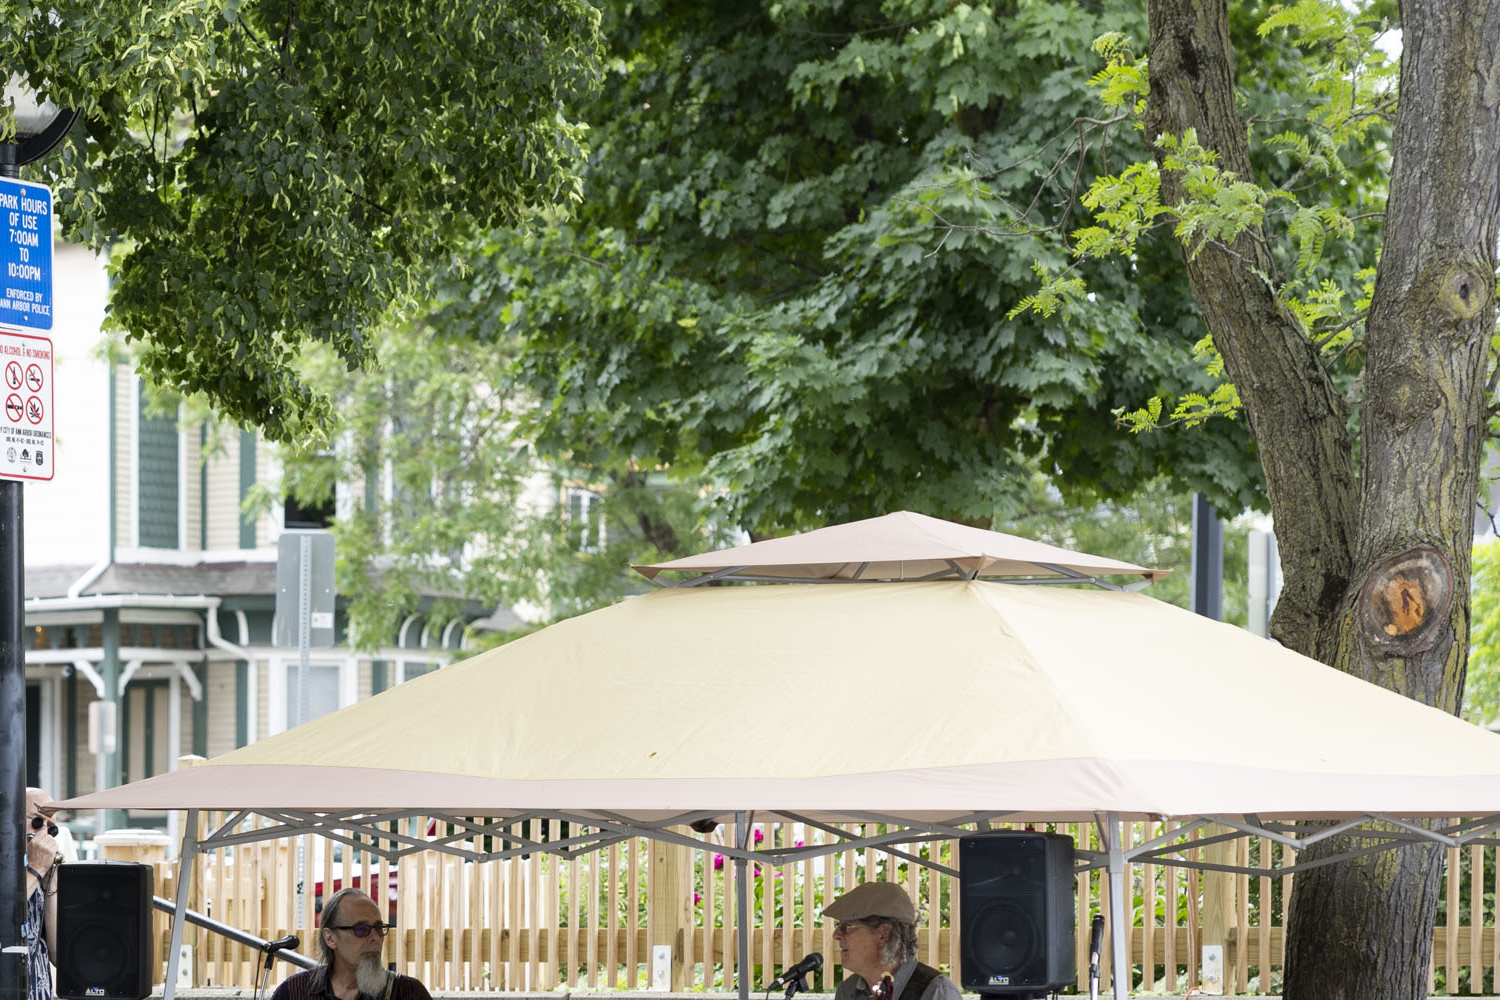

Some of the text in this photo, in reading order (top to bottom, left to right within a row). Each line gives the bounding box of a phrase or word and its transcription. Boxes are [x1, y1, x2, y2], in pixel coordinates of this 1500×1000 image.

[21, 197, 48, 215] HOURS
[9, 211, 38, 230] OF USE
[9, 228, 39, 247] 7:00AM
[19, 247, 29, 262] TO
[8, 262, 41, 281] 10:00PM
[6, 288, 43, 303] ENFORCED BY
[0, 298, 50, 316] ANN ARBOR POLICE
[4, 346, 21, 356] ALCOHOL
[989, 975, 1009, 985] ALTO
[85, 987, 105, 996] ALTO
